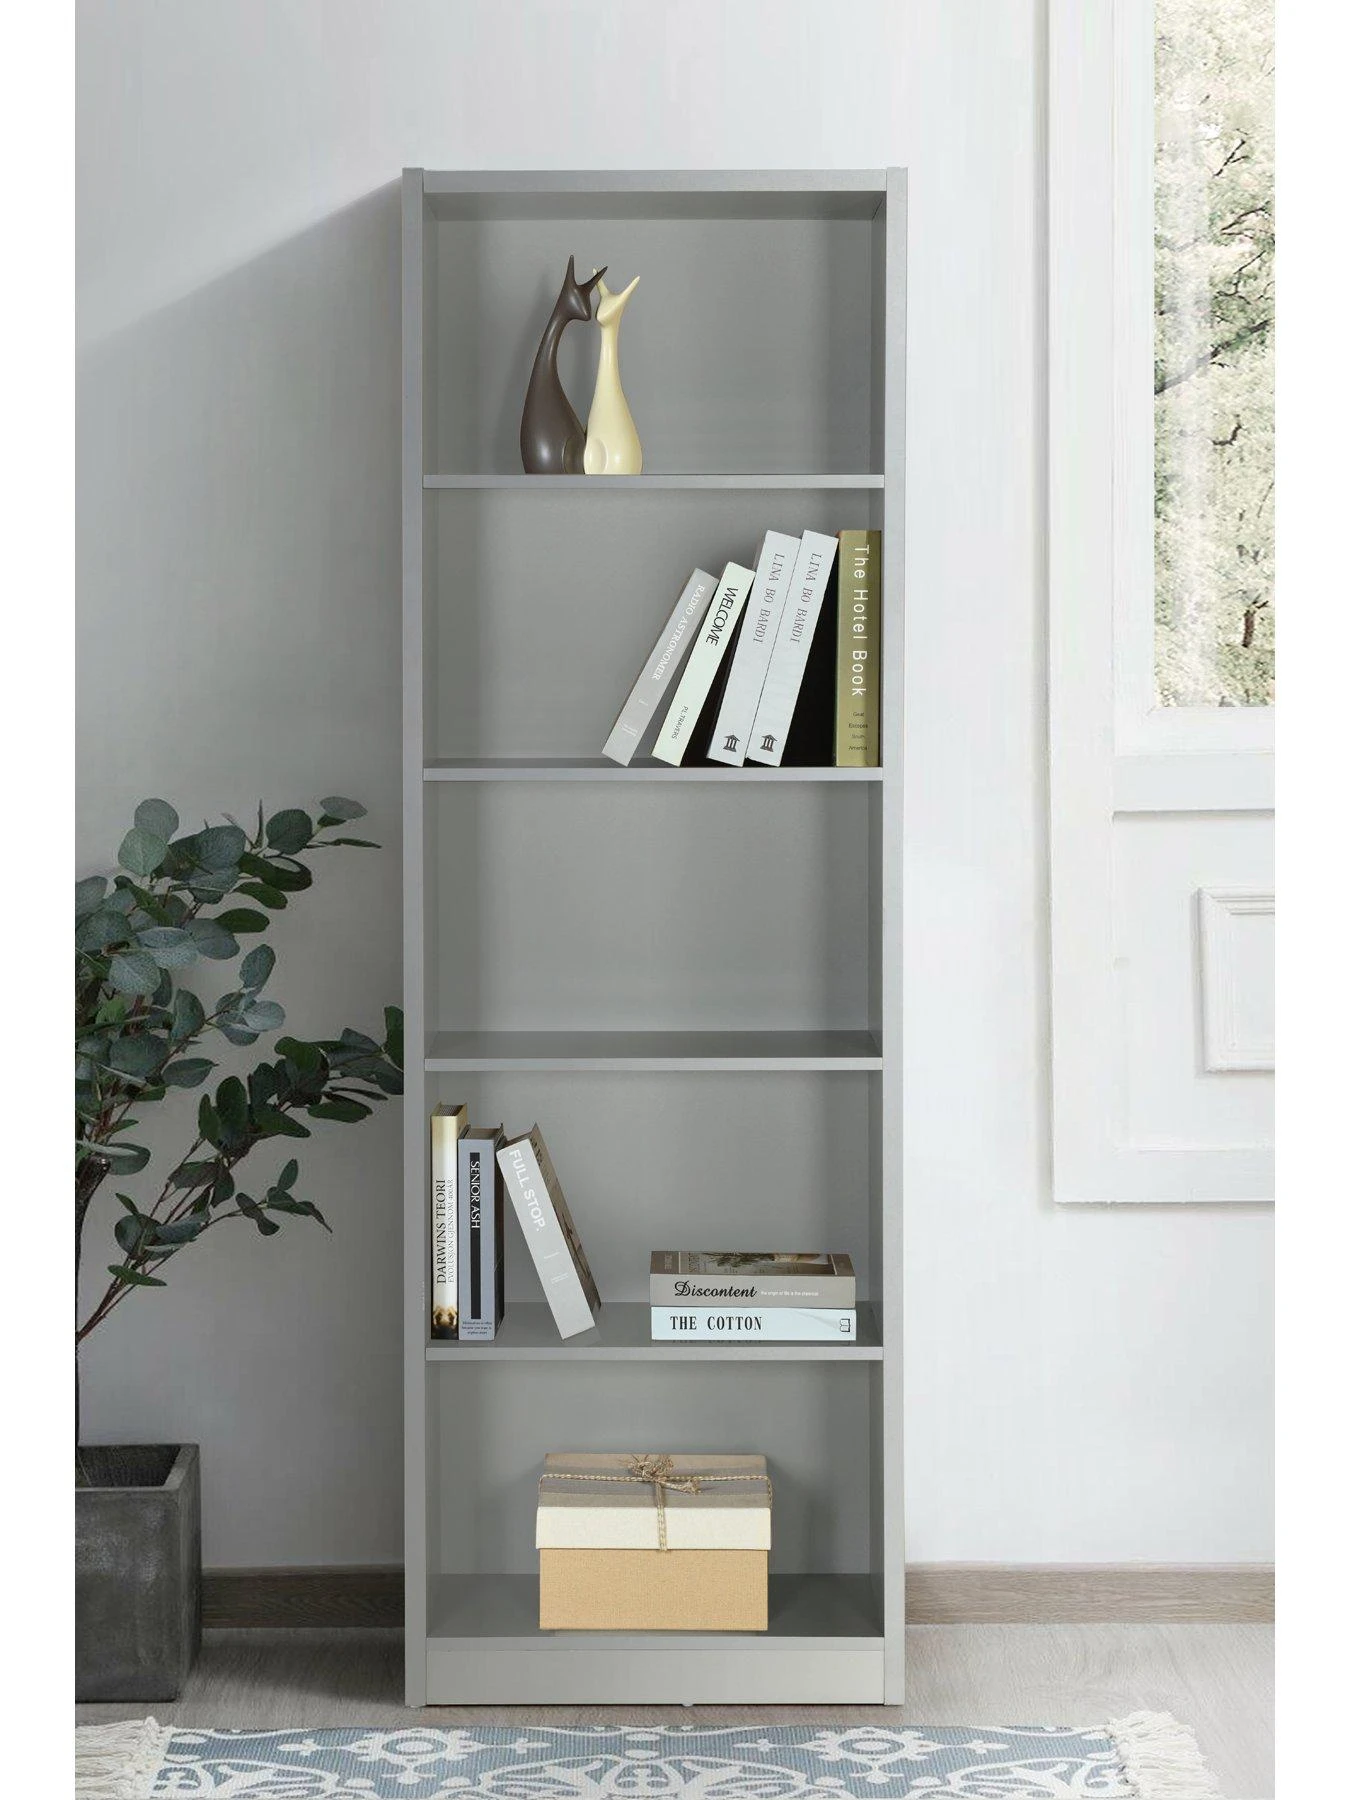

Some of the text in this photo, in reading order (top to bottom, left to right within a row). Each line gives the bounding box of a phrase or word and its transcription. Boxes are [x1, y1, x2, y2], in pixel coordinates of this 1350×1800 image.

[652, 584, 705, 682] RADIO ASTRONOMER
[706, 586, 739, 647] WELCOME
[752, 553, 785, 644] LINA BO BARDI
[789, 553, 822, 644] LINA BO BARDI
[851, 545, 870, 697] The Hotel Book
[470, 1160, 481, 1229] SENIOR ASH
[509, 1148, 527, 1189] FULL
[436, 1179, 447, 1285] DARWINS TEORI
[669, 1316, 763, 1331] THE COTTON
[674, 1280, 758, 1299] Discontent
